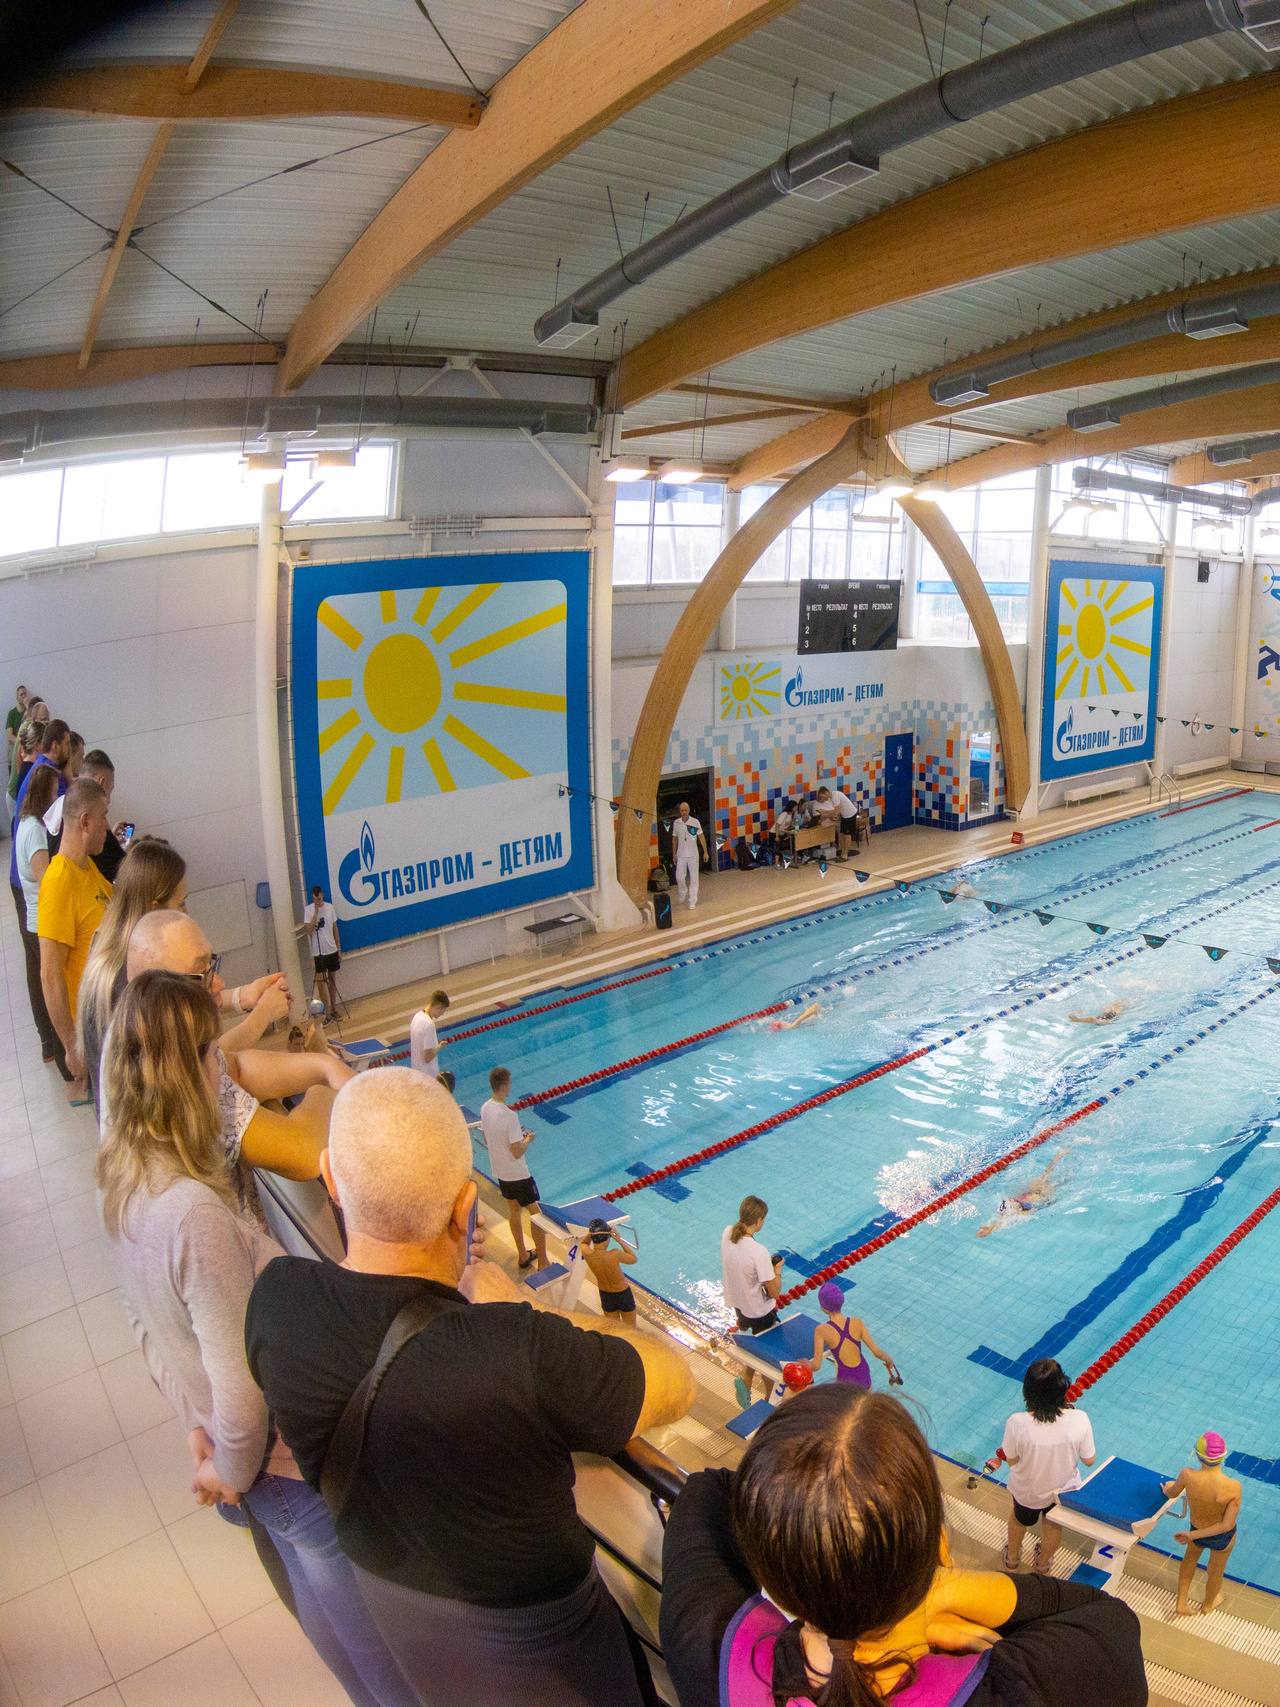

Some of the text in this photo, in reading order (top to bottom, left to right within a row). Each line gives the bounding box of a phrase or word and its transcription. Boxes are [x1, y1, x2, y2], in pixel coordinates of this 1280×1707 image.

[806, 612, 810, 620] 1
[853, 611, 858, 619] 4
[805, 626, 810, 634] 2
[852, 624, 857, 632] 5
[805, 640, 809, 648] 3
[852, 638, 857, 646] 6
[803, 687, 845, 706] ГАЗПРОМ
[855, 683, 884, 702] ДЕТЯМ
[1073, 730, 1110, 752] ГАЗПРОМ
[1118, 725, 1144, 746] ДЕТЯМ
[381, 851, 474, 901] ГАЗПРОМ
[499, 832, 563, 876] ДЕТЯМ
[568, 1244, 578, 1261] 4
